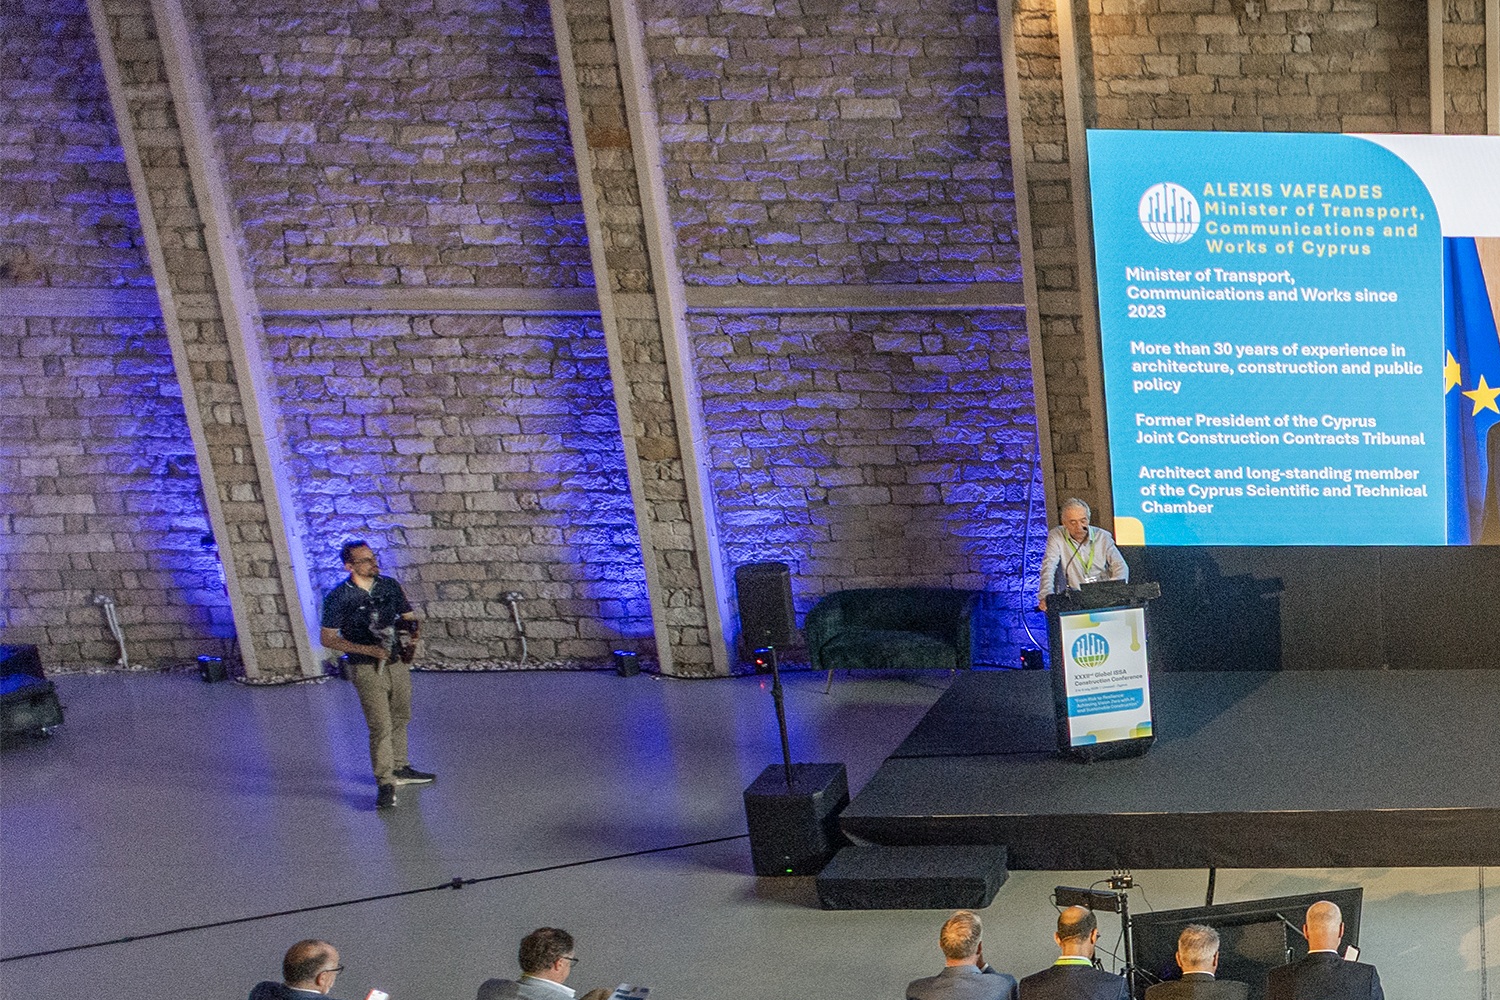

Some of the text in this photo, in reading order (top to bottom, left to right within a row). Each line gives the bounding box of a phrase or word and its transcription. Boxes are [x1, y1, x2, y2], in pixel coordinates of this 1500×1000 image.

[1204, 183, 1382, 198] ALEXIS VAFEADES
[1205, 202, 1424, 220] Minister of Transport,
[1206, 221, 1417, 236] Communications and
[1206, 240, 1370, 257] Works of Cyprus
[1126, 267, 1295, 285] Minister of Transport,
[1126, 286, 1397, 302] Communications and Works since
[1128, 304, 1166, 318] 2023
[1131, 341, 1405, 359] More than 30 years of experience in
[1132, 359, 1422, 377] architecture, construction and public
[1134, 378, 1181, 394] policy
[1136, 414, 1376, 430] Former President of the Cyprus
[1136, 431, 1425, 445] Joint Construction Contracts Tribunal
[1139, 466, 1419, 482] Architect and long-standing member
[1140, 484, 1428, 499] of the Cyprus Scientific and Technical
[1142, 501, 1213, 513] Chamber
[1075, 678, 1110, 686] Construction
